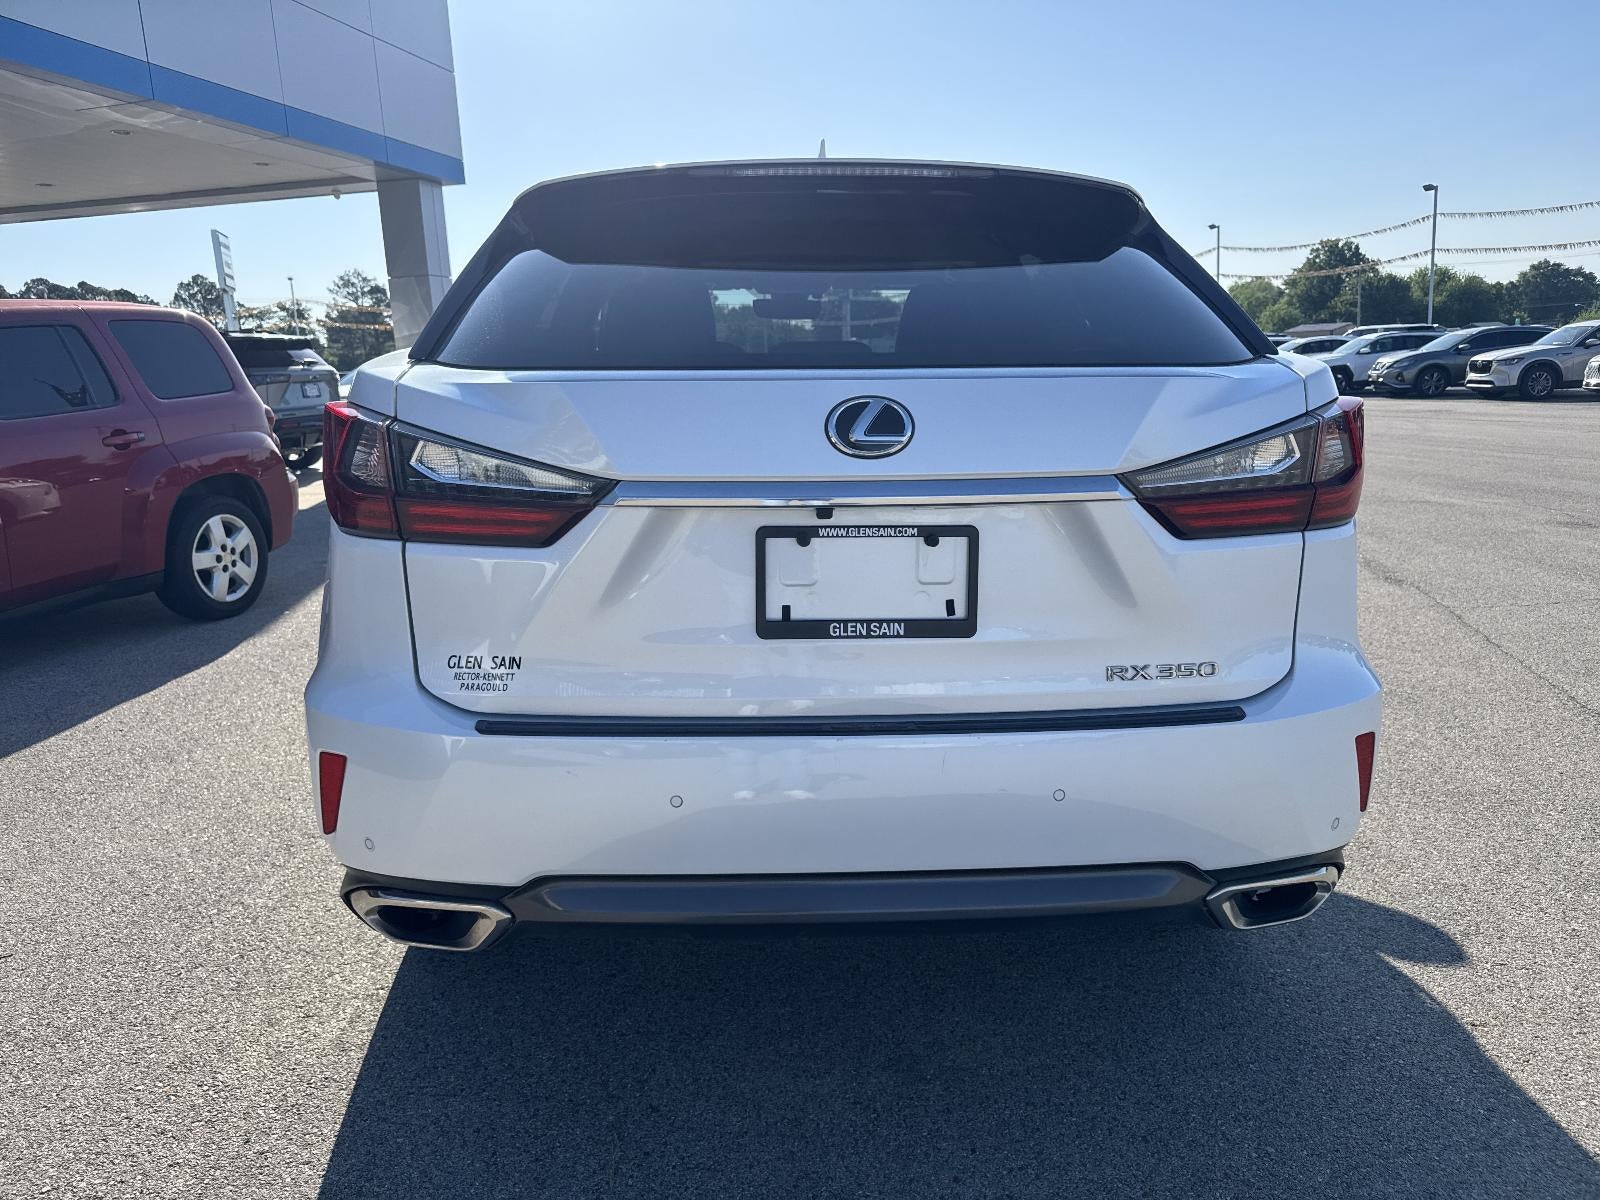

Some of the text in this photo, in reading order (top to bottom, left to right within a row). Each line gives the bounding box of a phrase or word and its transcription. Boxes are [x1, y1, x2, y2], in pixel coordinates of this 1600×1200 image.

[818, 527, 918, 537] WWW.GLENSAIN.COM
[829, 622, 905, 636] GLEN SAIN
[447, 655, 522, 670] GLEN SAIN
[453, 672, 515, 682] RECTOR-KENNETT
[459, 682, 509, 692] PARAGOULD
